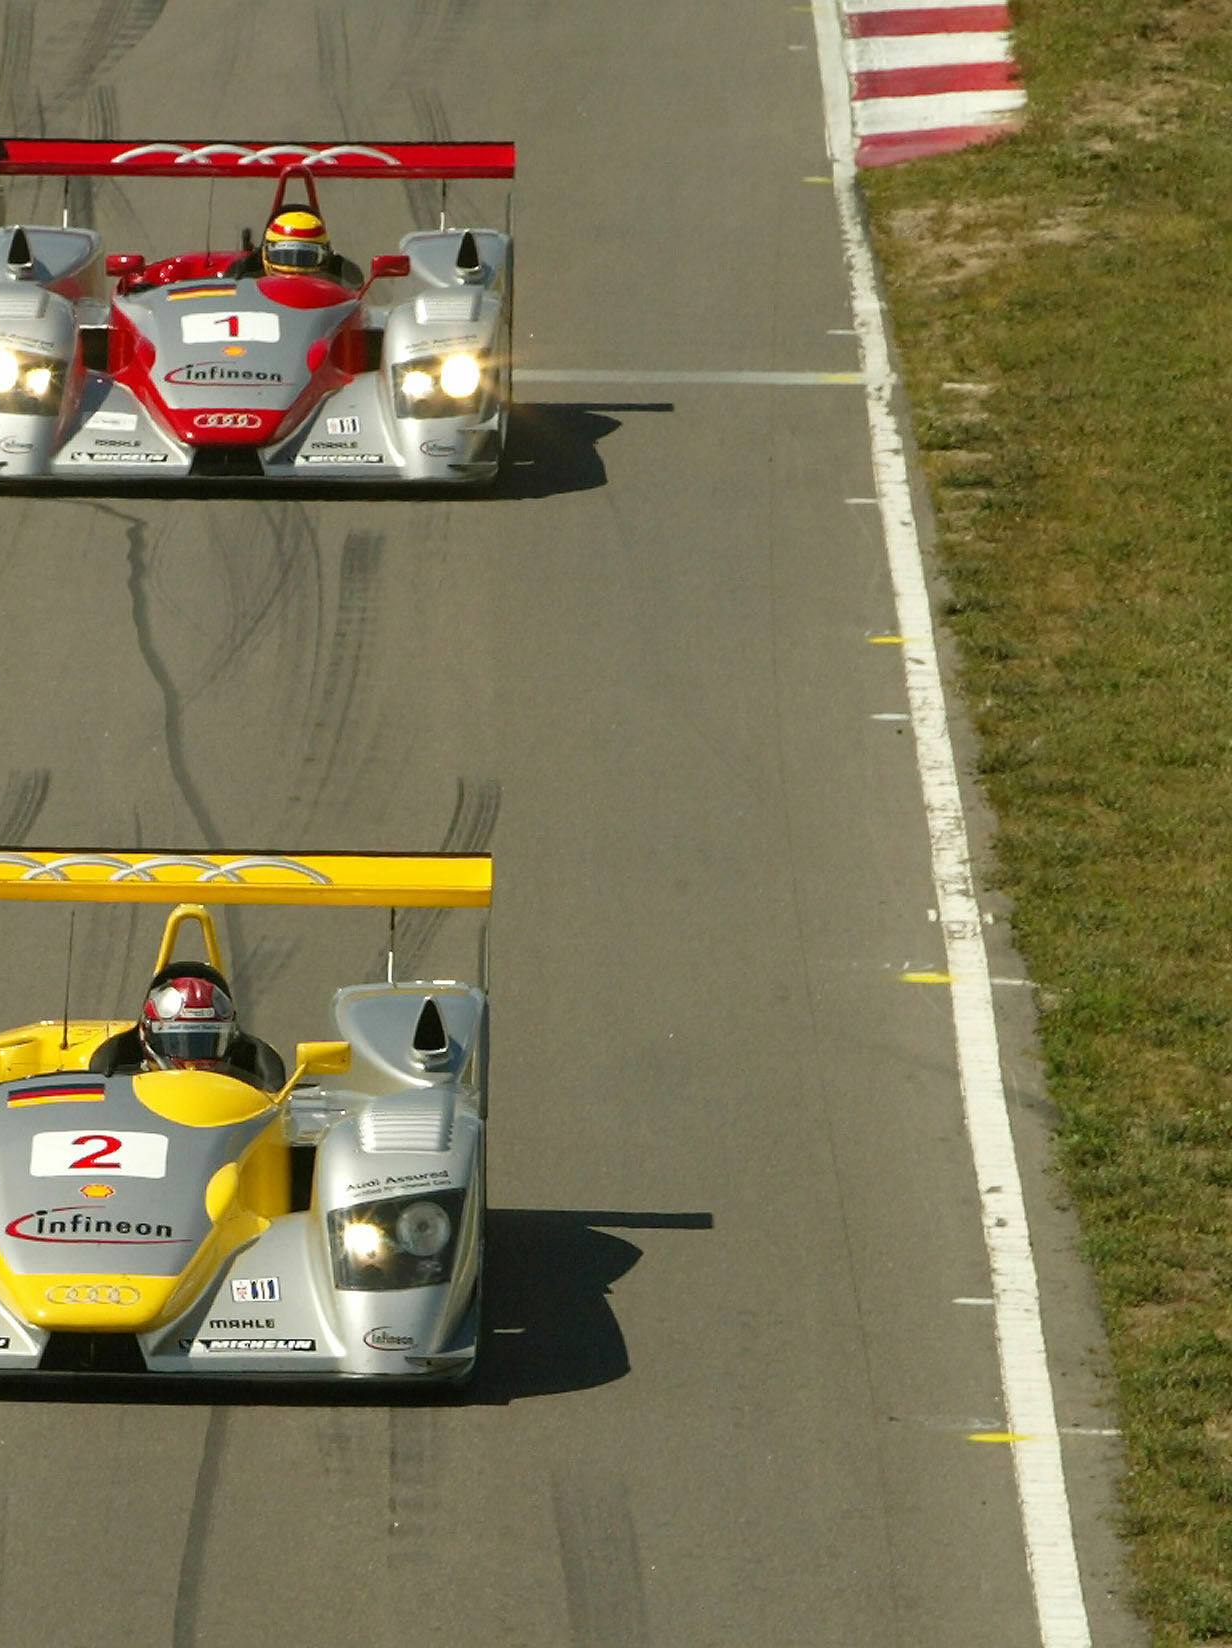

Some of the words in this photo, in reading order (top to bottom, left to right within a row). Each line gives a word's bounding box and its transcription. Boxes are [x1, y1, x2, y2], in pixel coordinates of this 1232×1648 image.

[213, 315, 239, 337] 1
[68, 1134, 122, 1169] 2
[385, 1170, 449, 1184] Assured
[210, 1319, 275, 1329] MAHLE
[210, 1339, 313, 1350] MICHELIN
